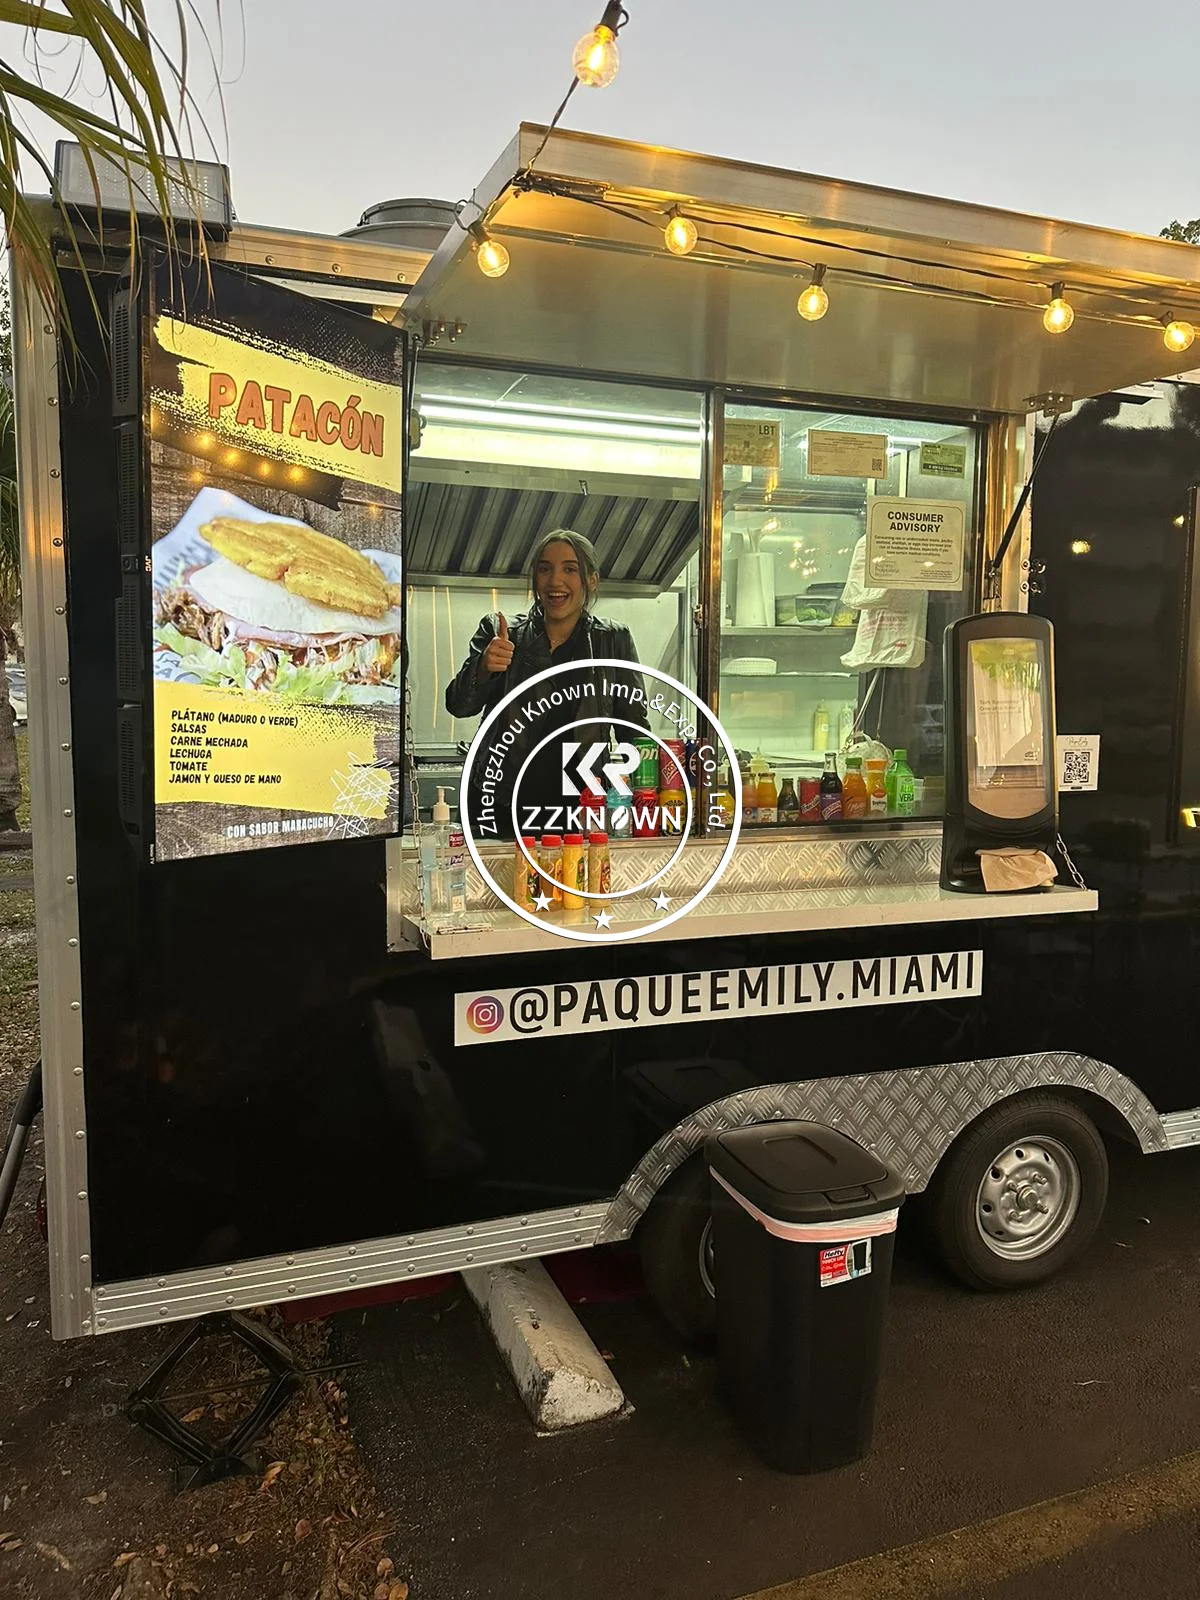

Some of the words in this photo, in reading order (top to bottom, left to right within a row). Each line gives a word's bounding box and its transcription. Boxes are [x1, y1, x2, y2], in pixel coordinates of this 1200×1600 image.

[208, 372, 384, 457] PATACÓN
[887, 511, 944, 523] CONSUMER
[889, 521, 941, 533] ADVISORY
[171, 708, 215, 722] PLÁTANO
[218, 711, 257, 725] (MADURO
[260, 715, 265, 724] O
[268, 716, 299, 728] VERDE)
[171, 723, 207, 734] SALSAS
[170, 736, 202, 746] CARNE
[205, 737, 248, 748] MECHADA
[169, 748, 212, 759] LECHUGA
[169, 761, 208, 771] TOMATE
[169, 774, 201, 784] JAMON
[204, 774, 210, 784] Y
[213, 774, 241, 784] QUESO
[244, 774, 256, 784] DE
[258, 775, 282, 784] MANO
[227, 824, 246, 839] CON
[248, 821, 280, 836] SABOR
[281, 815, 334, 833] MARACUCHO
[509, 951, 976, 1034] @PAQUEEMILY.MIAMI
